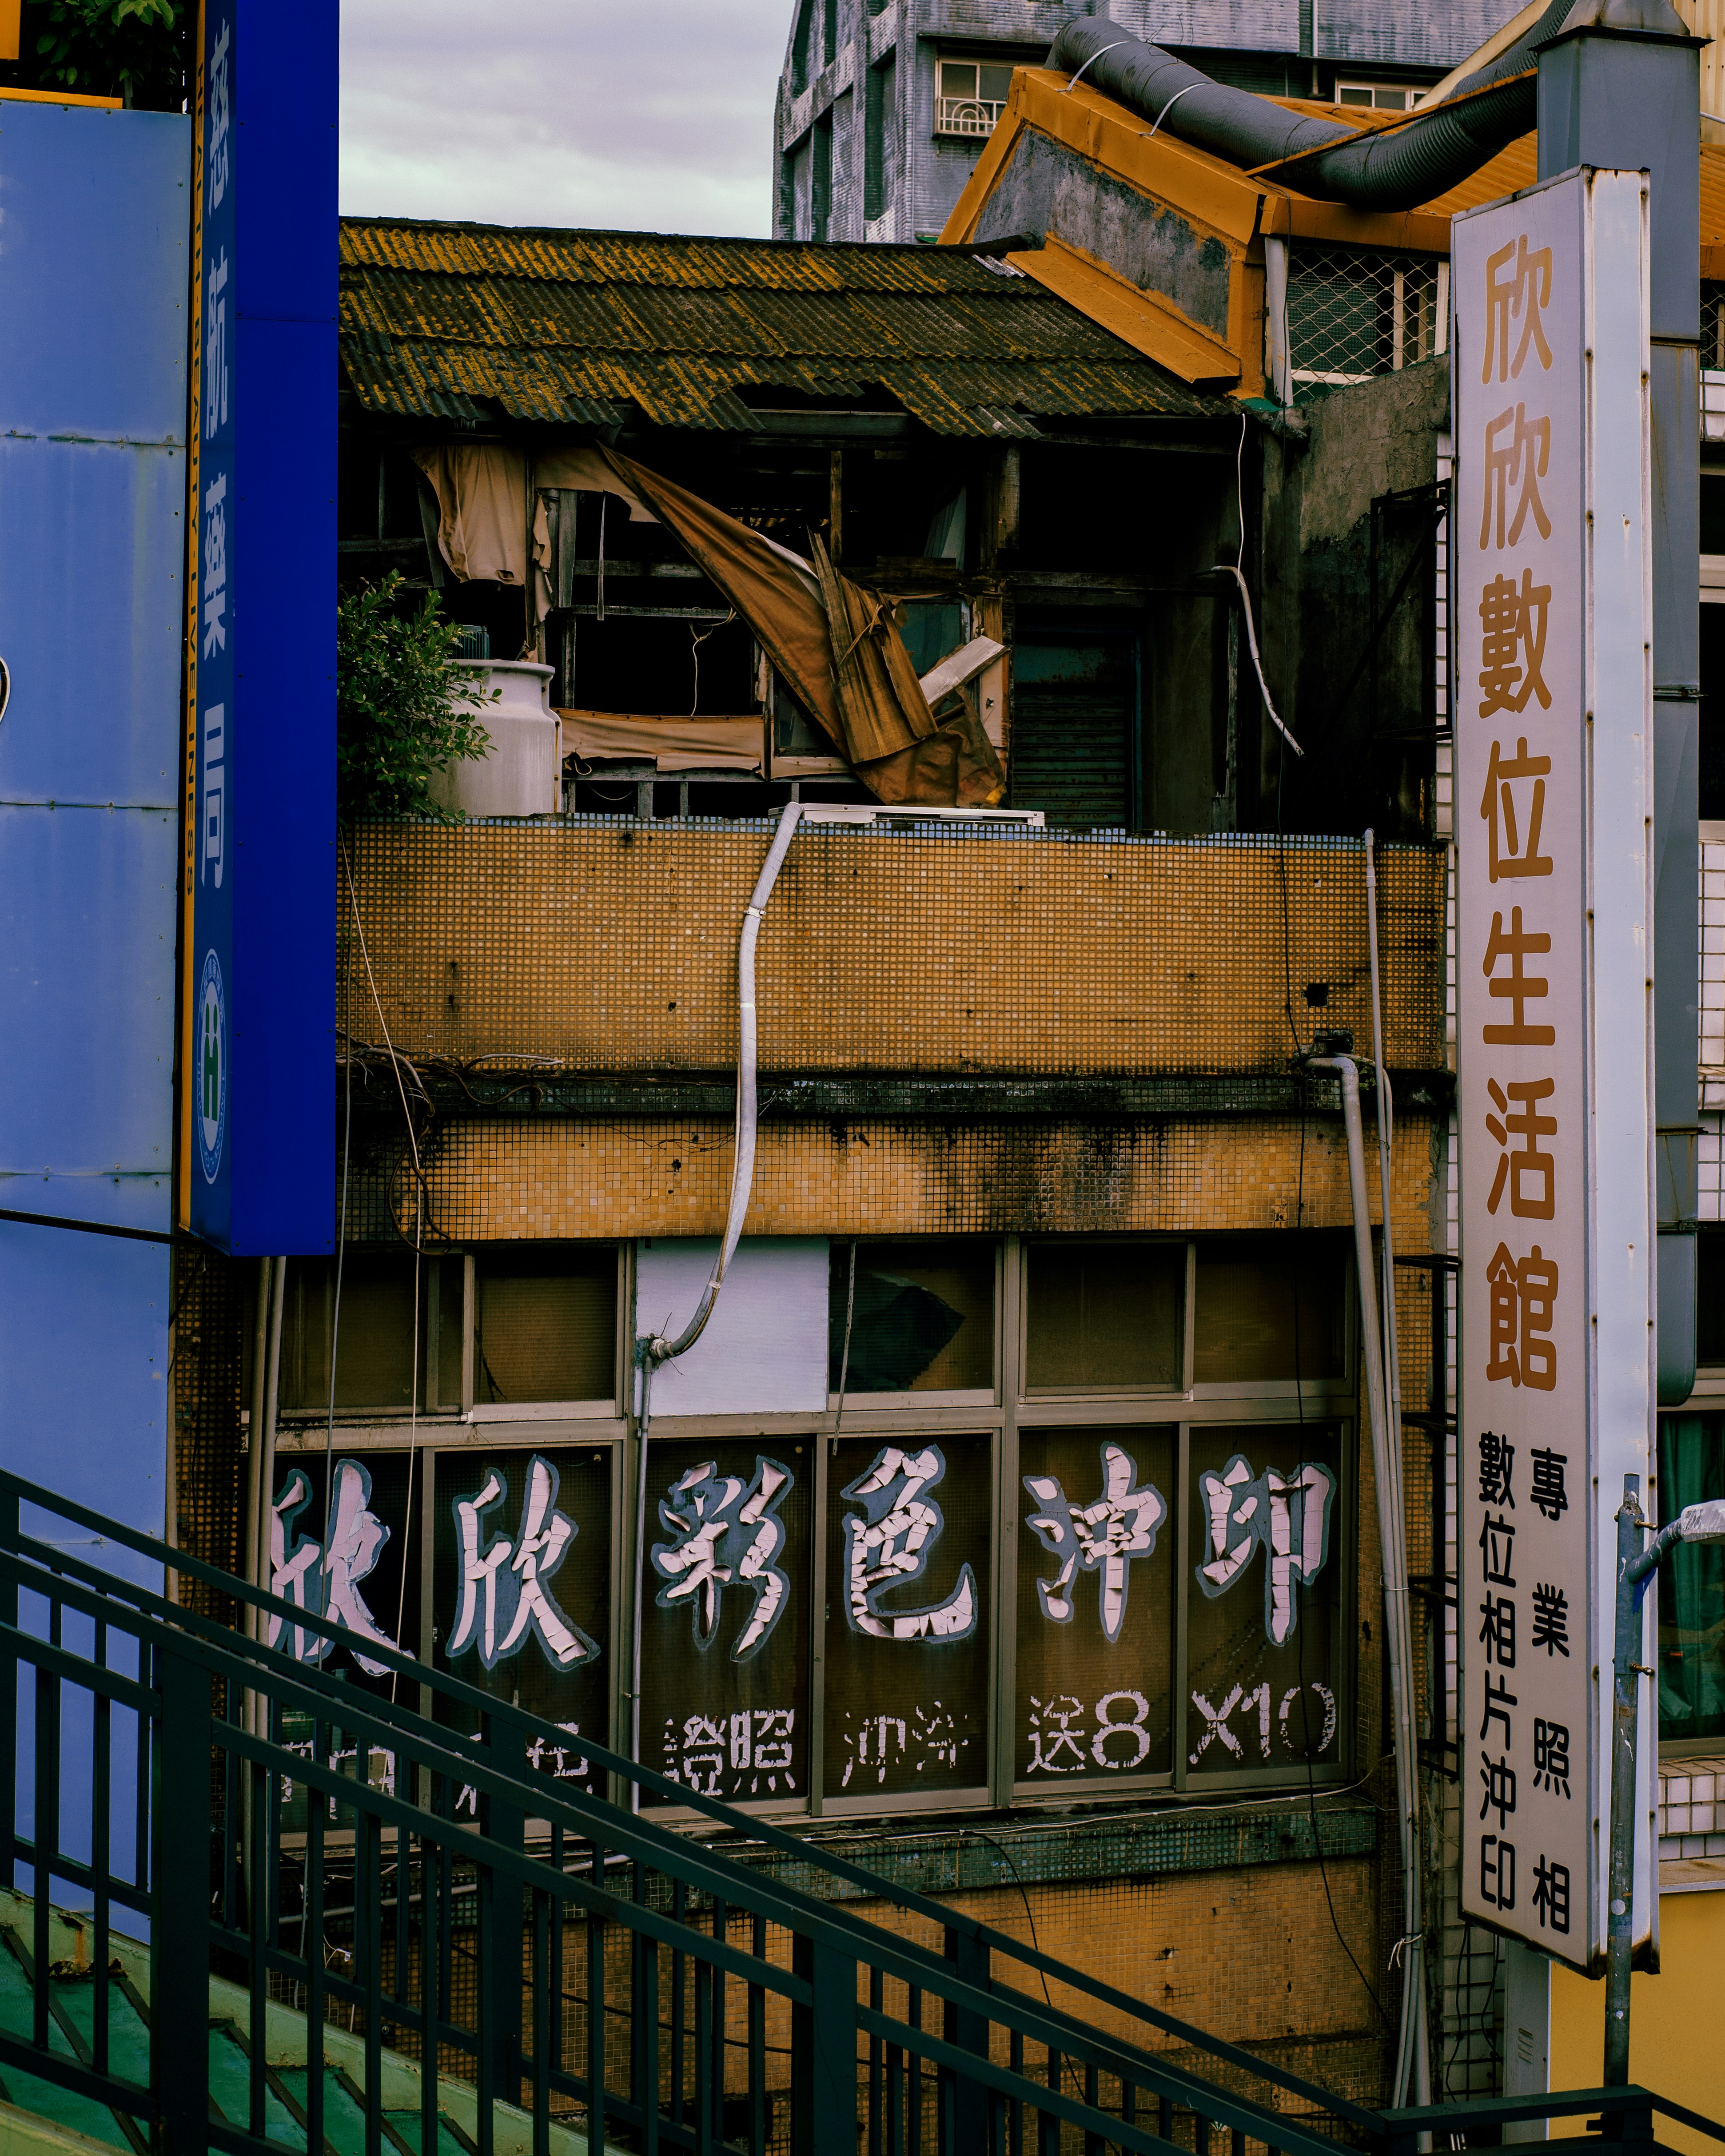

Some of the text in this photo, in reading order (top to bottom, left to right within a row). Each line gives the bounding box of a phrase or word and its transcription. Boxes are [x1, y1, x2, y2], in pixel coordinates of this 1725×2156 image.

[201, 18, 229, 889] 慈航藥局
[1478, 234, 1558, 1392] 欣欣數位生活館
[1479, 1431, 1518, 1911] 數位相片沖印
[1530, 1447, 1570, 1934] 專業照相
